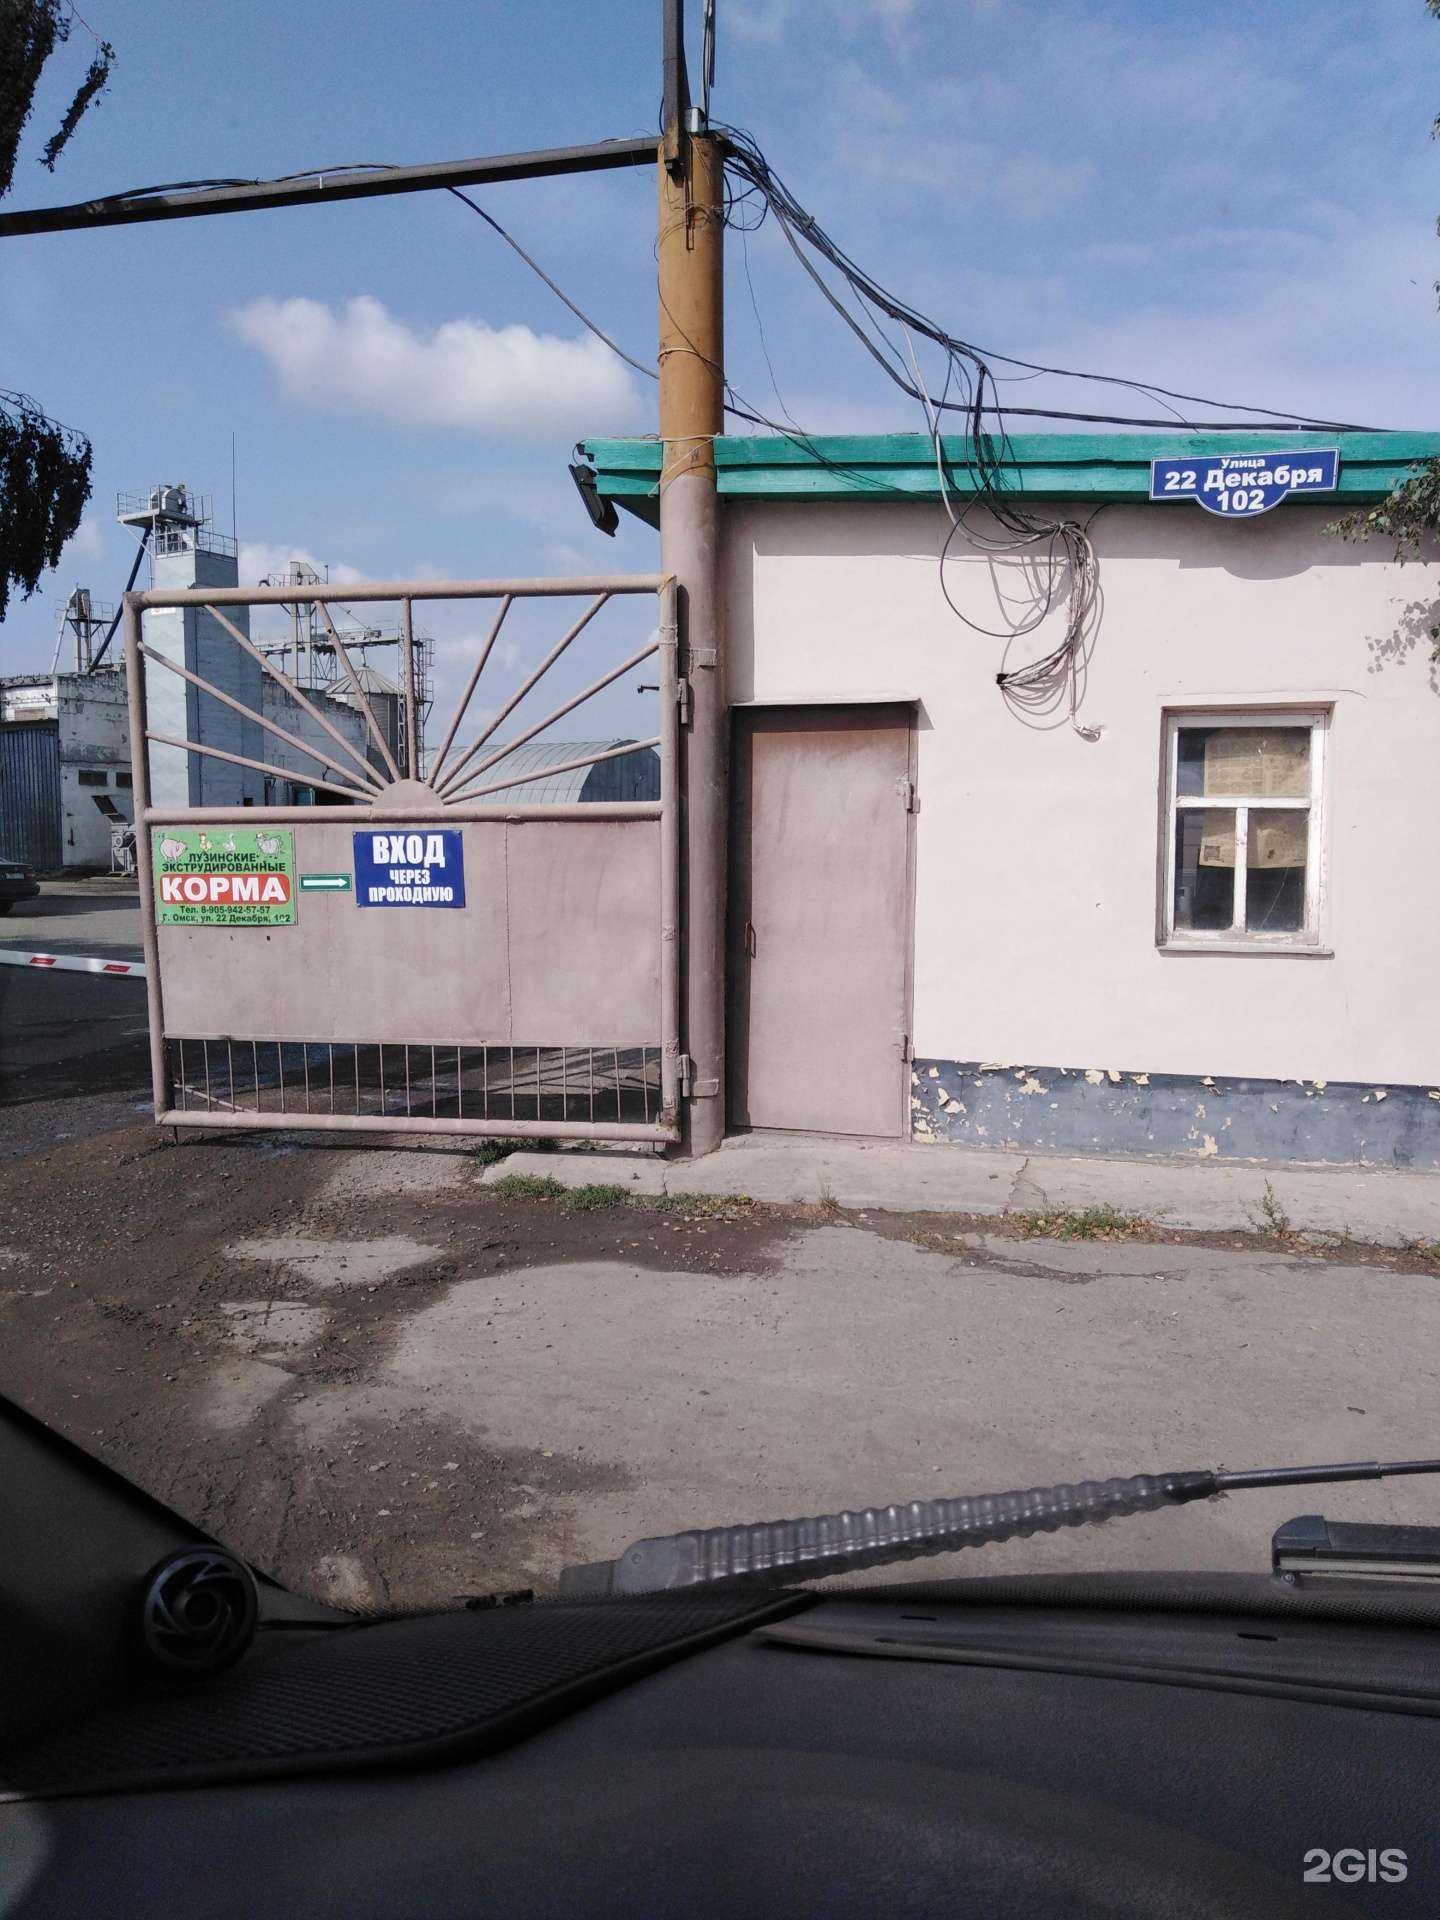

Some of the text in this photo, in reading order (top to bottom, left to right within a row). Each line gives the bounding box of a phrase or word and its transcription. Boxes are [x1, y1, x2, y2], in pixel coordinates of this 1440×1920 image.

[1221, 458, 1266, 469] Улица
[1164, 465, 1323, 492] 22 Декабря
[1216, 490, 1265, 511] 102
[189, 852, 256, 863] ЛУЗИНСКИЕ
[372, 835, 446, 868] ВХОД
[162, 862, 287, 873] ЭКСТРУДИРОВАННЫЕ
[389, 869, 431, 885] ЧЕРЕЗ
[161, 877, 287, 901] КОРМА
[368, 886, 454, 904] ПРОХОДНУЮ
[179, 905, 199, 914] Тел.
[200, 914, 214, 923] ул.
[216, 913, 227, 922] 22
[229, 913, 271, 924] Декабря,
